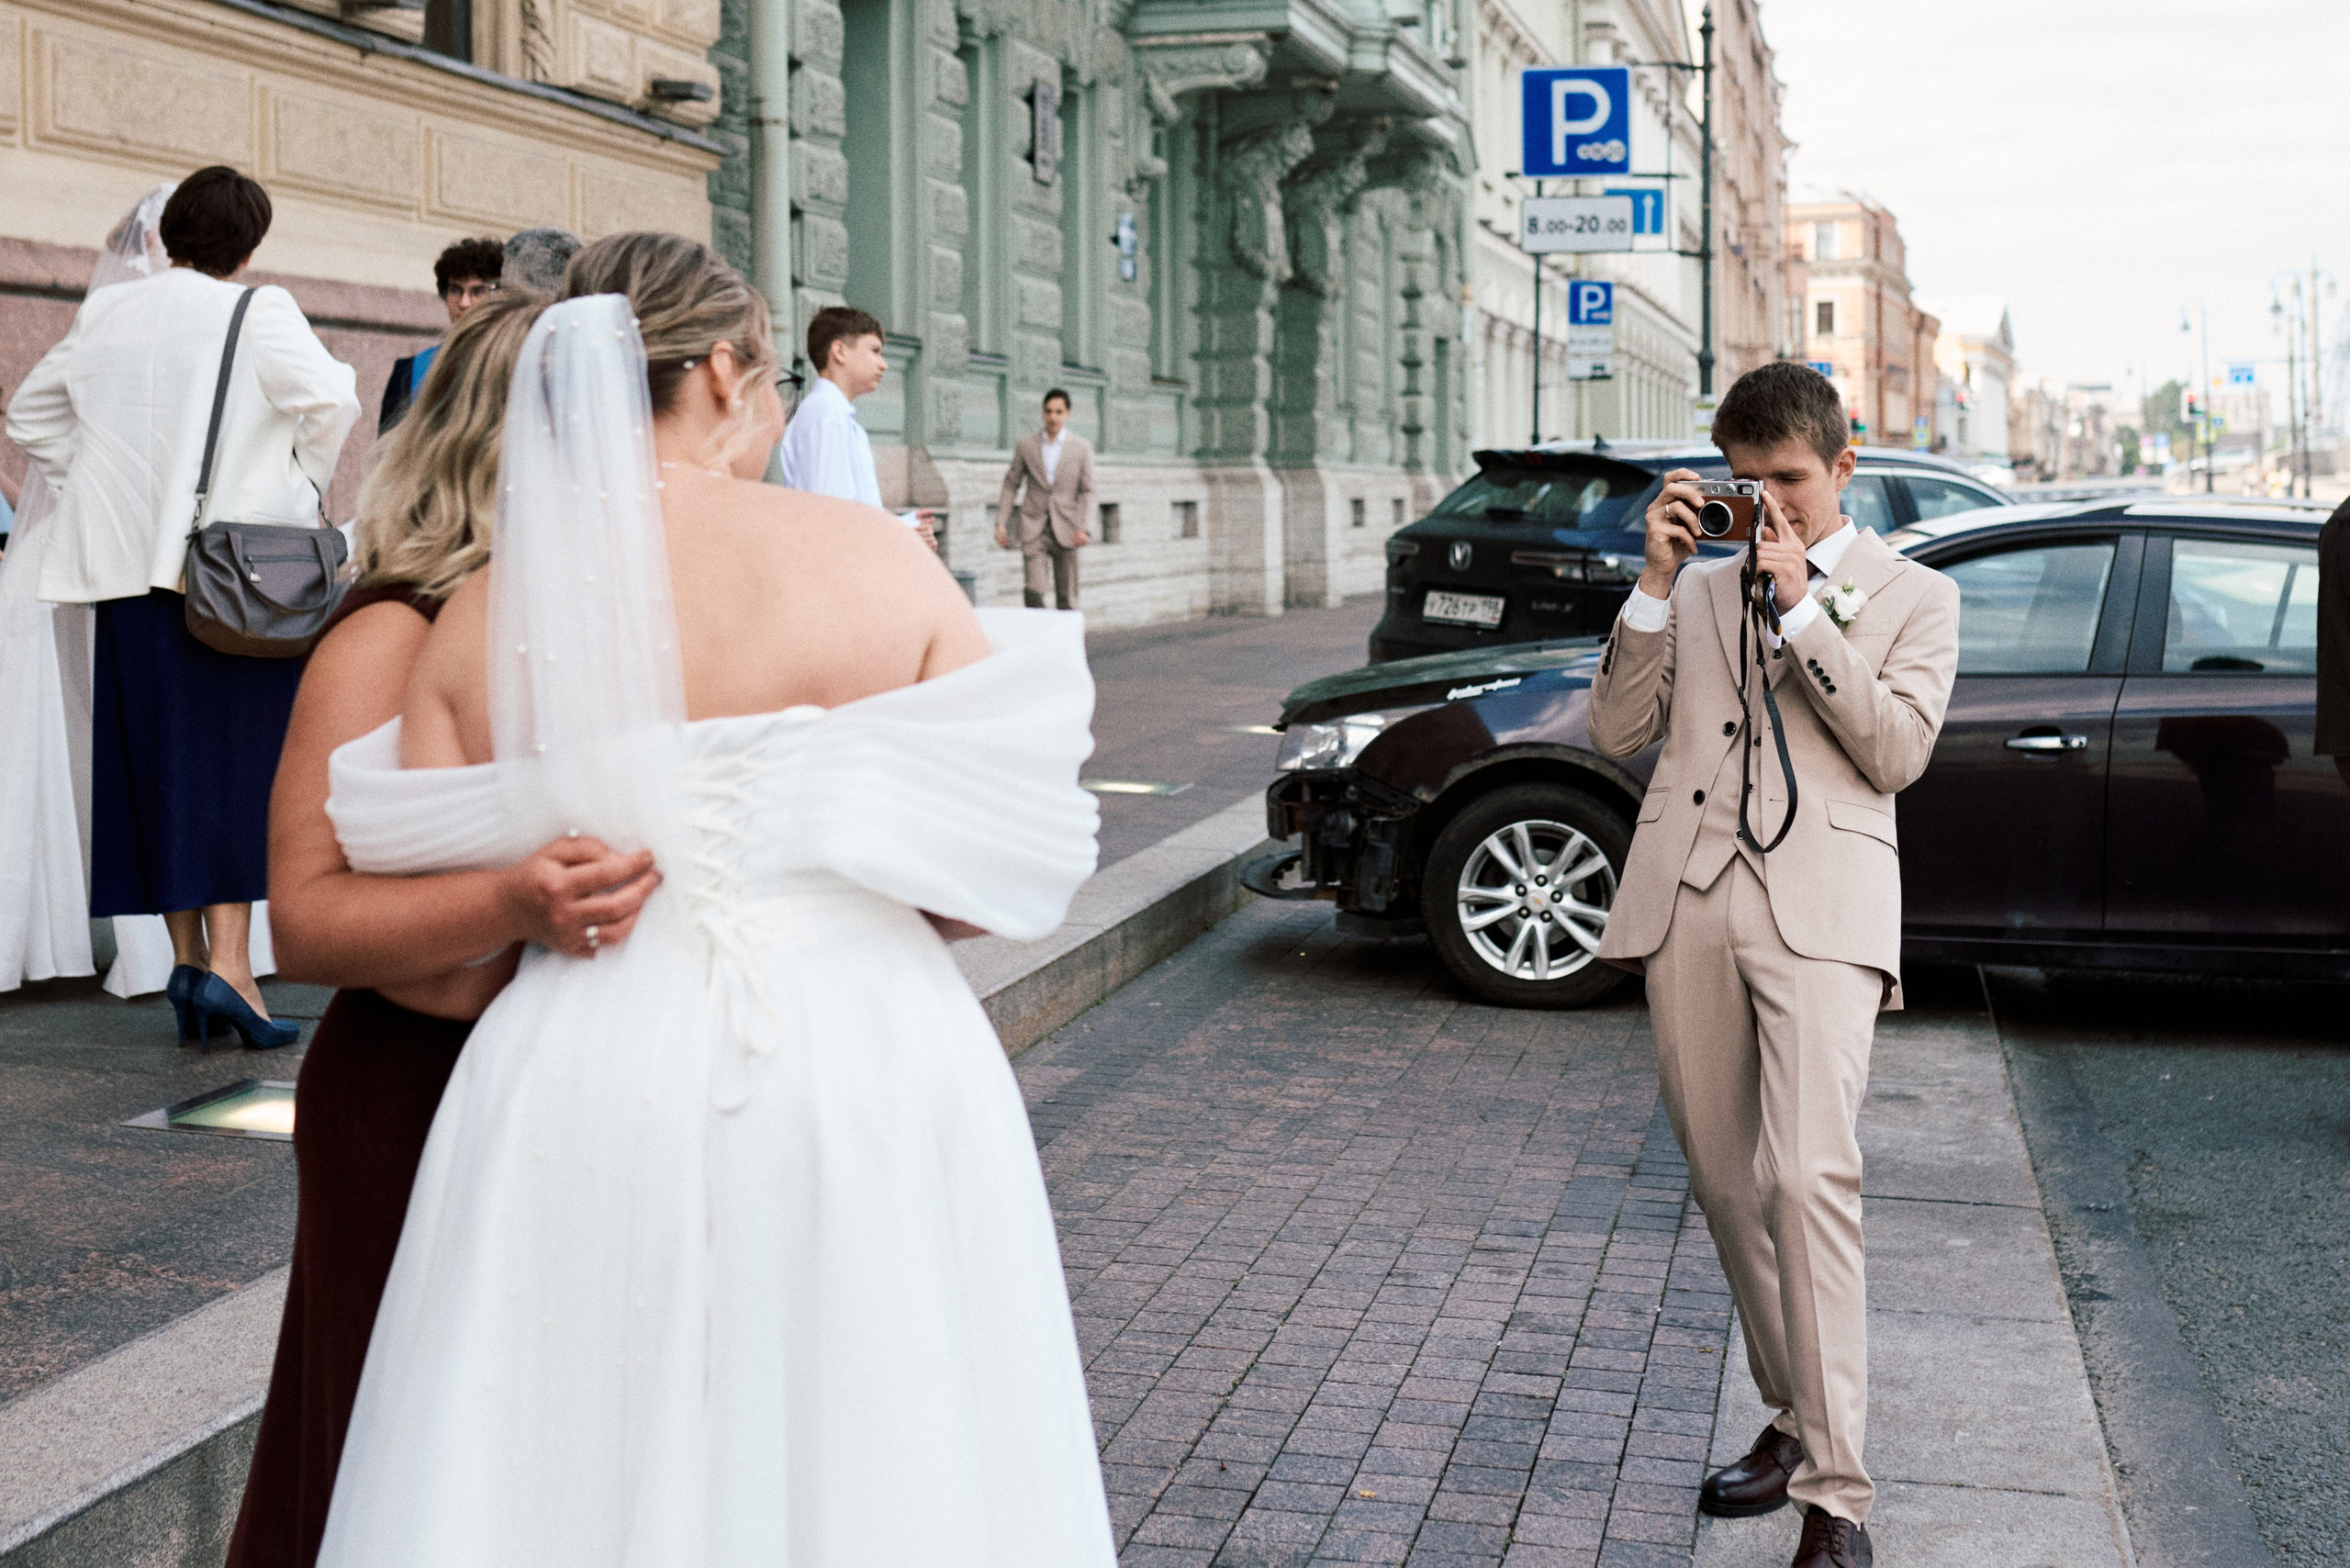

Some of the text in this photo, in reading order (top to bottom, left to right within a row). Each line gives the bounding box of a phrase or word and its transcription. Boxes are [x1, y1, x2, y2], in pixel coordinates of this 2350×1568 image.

[1550, 78, 1612, 166] P
[1527, 214, 1628, 234] 8.00-20.00
[1579, 285, 1606, 321] P
